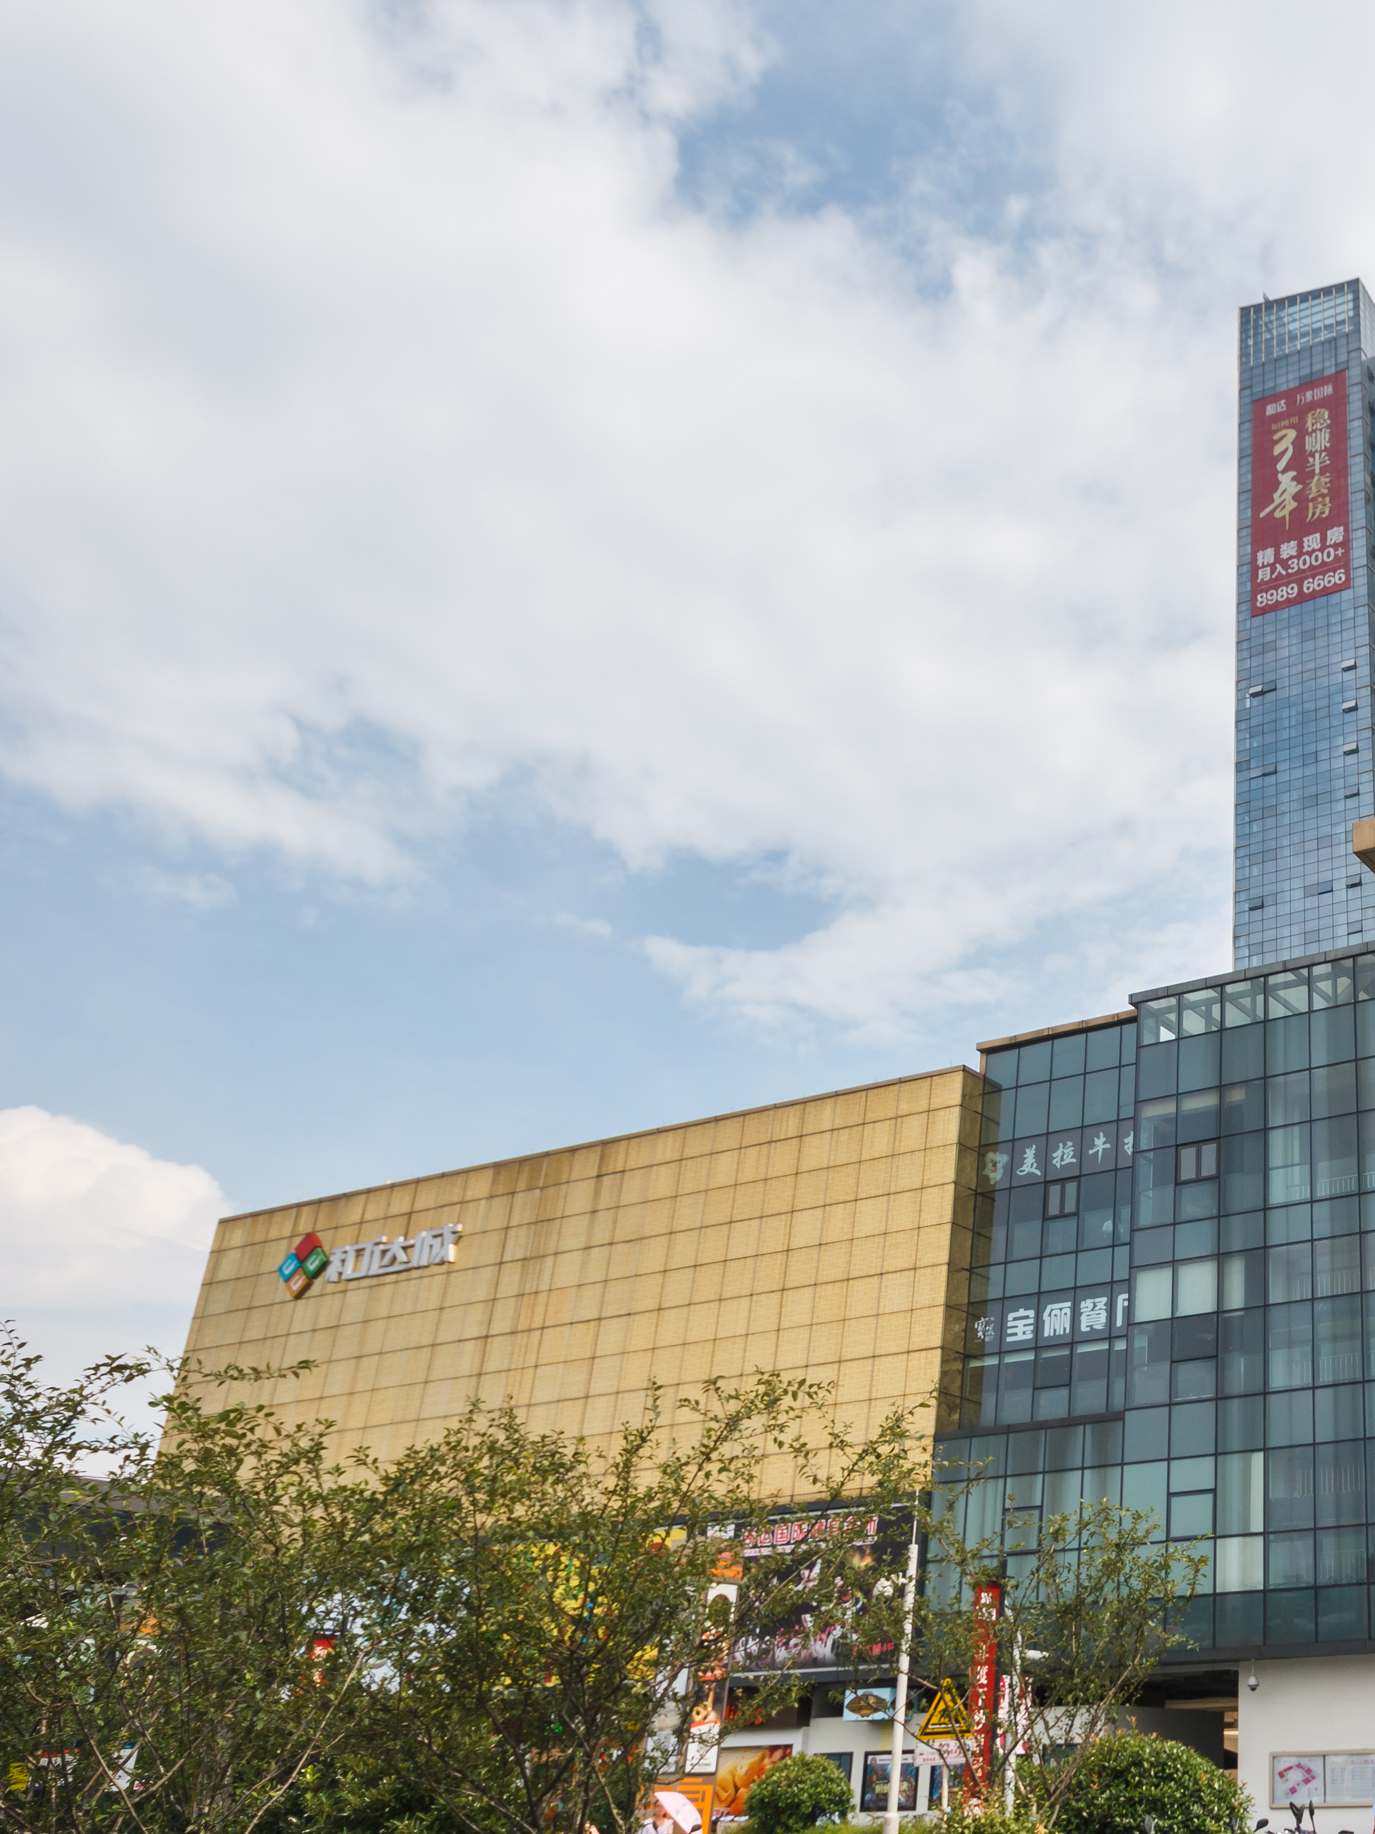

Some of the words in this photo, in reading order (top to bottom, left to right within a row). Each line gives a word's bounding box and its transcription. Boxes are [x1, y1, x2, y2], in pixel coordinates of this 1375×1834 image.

[1304, 408, 1331, 523] 稳赚半套房
[1257, 526, 1344, 567] 精装现房
[1257, 546, 1345, 583] 月入3000+
[1256, 583, 1298, 608] 8989
[1303, 568, 1346, 594] 6666
[324, 1223, 464, 1283] 和达城
